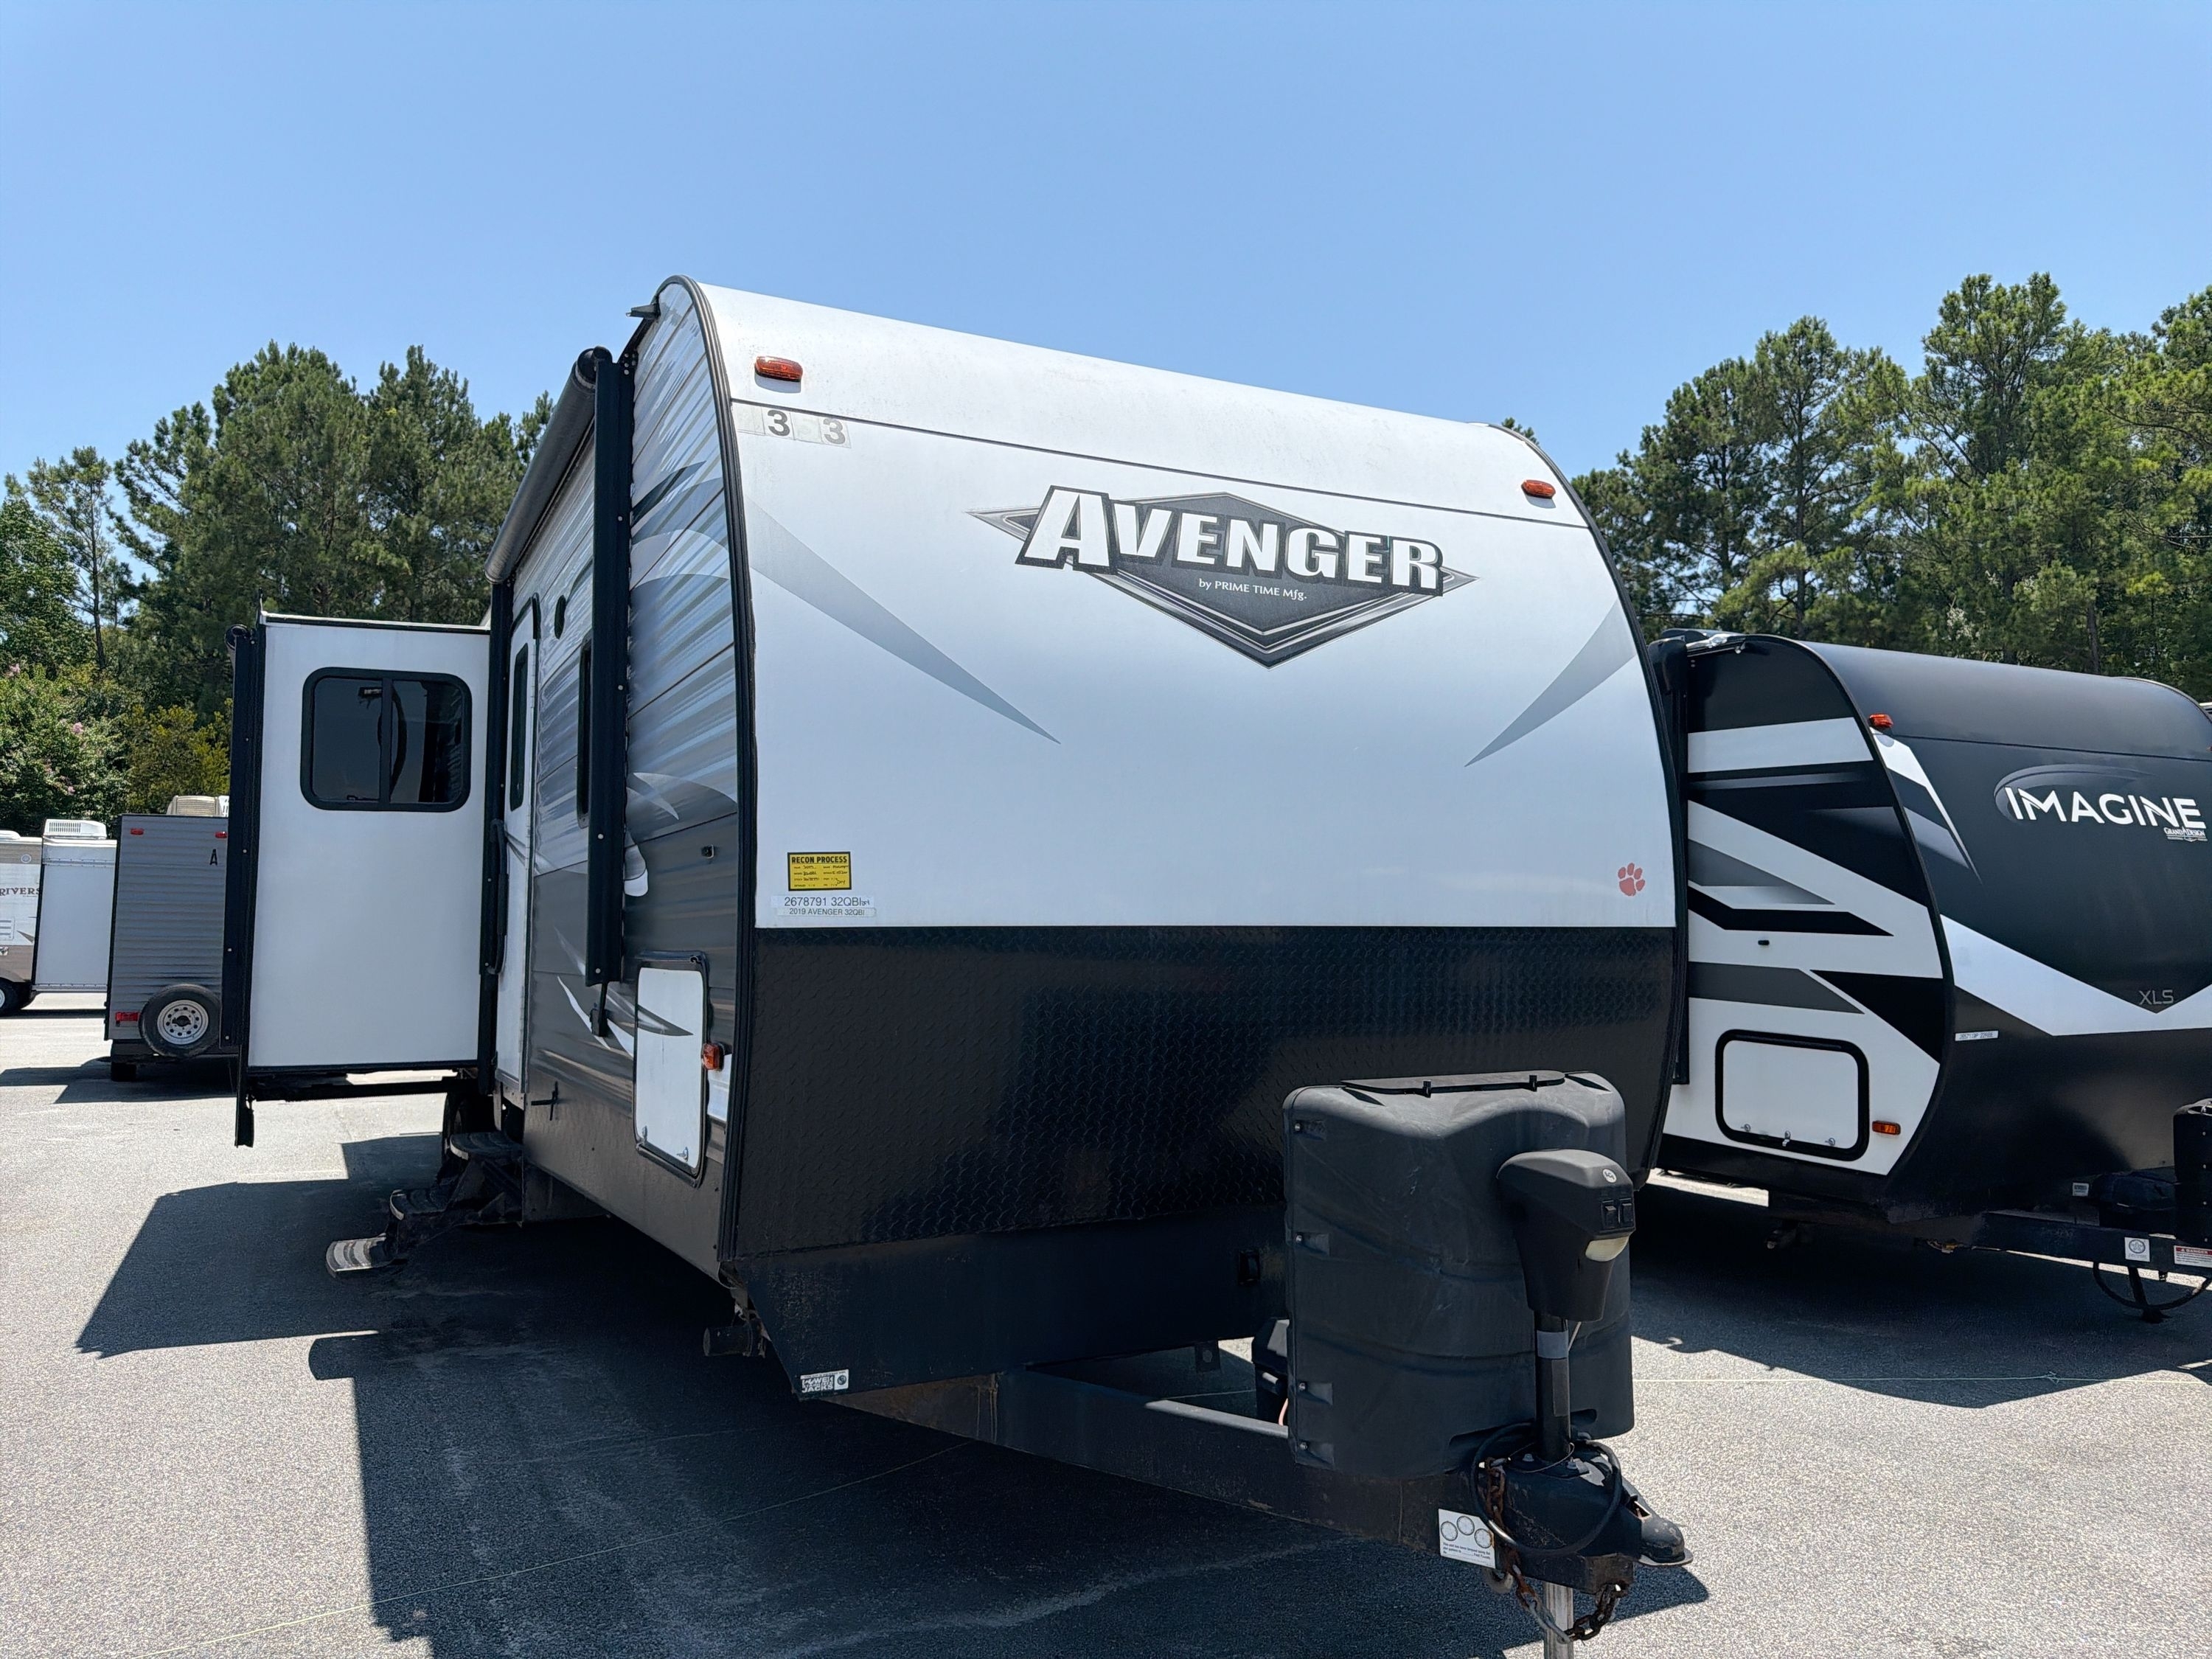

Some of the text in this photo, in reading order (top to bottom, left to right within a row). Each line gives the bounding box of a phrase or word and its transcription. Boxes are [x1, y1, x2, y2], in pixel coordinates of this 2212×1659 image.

[768, 410, 846, 444] 3 3
[1015, 485, 1443, 596] AVENGER
[1199, 578, 1307, 601] by PRIME TIME Mfg.
[2005, 787, 2206, 829] IMAGINE
[817, 855, 847, 863] PROCESS
[785, 897, 827, 906] 2678791
[807, 908, 843, 916] AVENGER
[2139, 990, 2174, 1005] XLS
